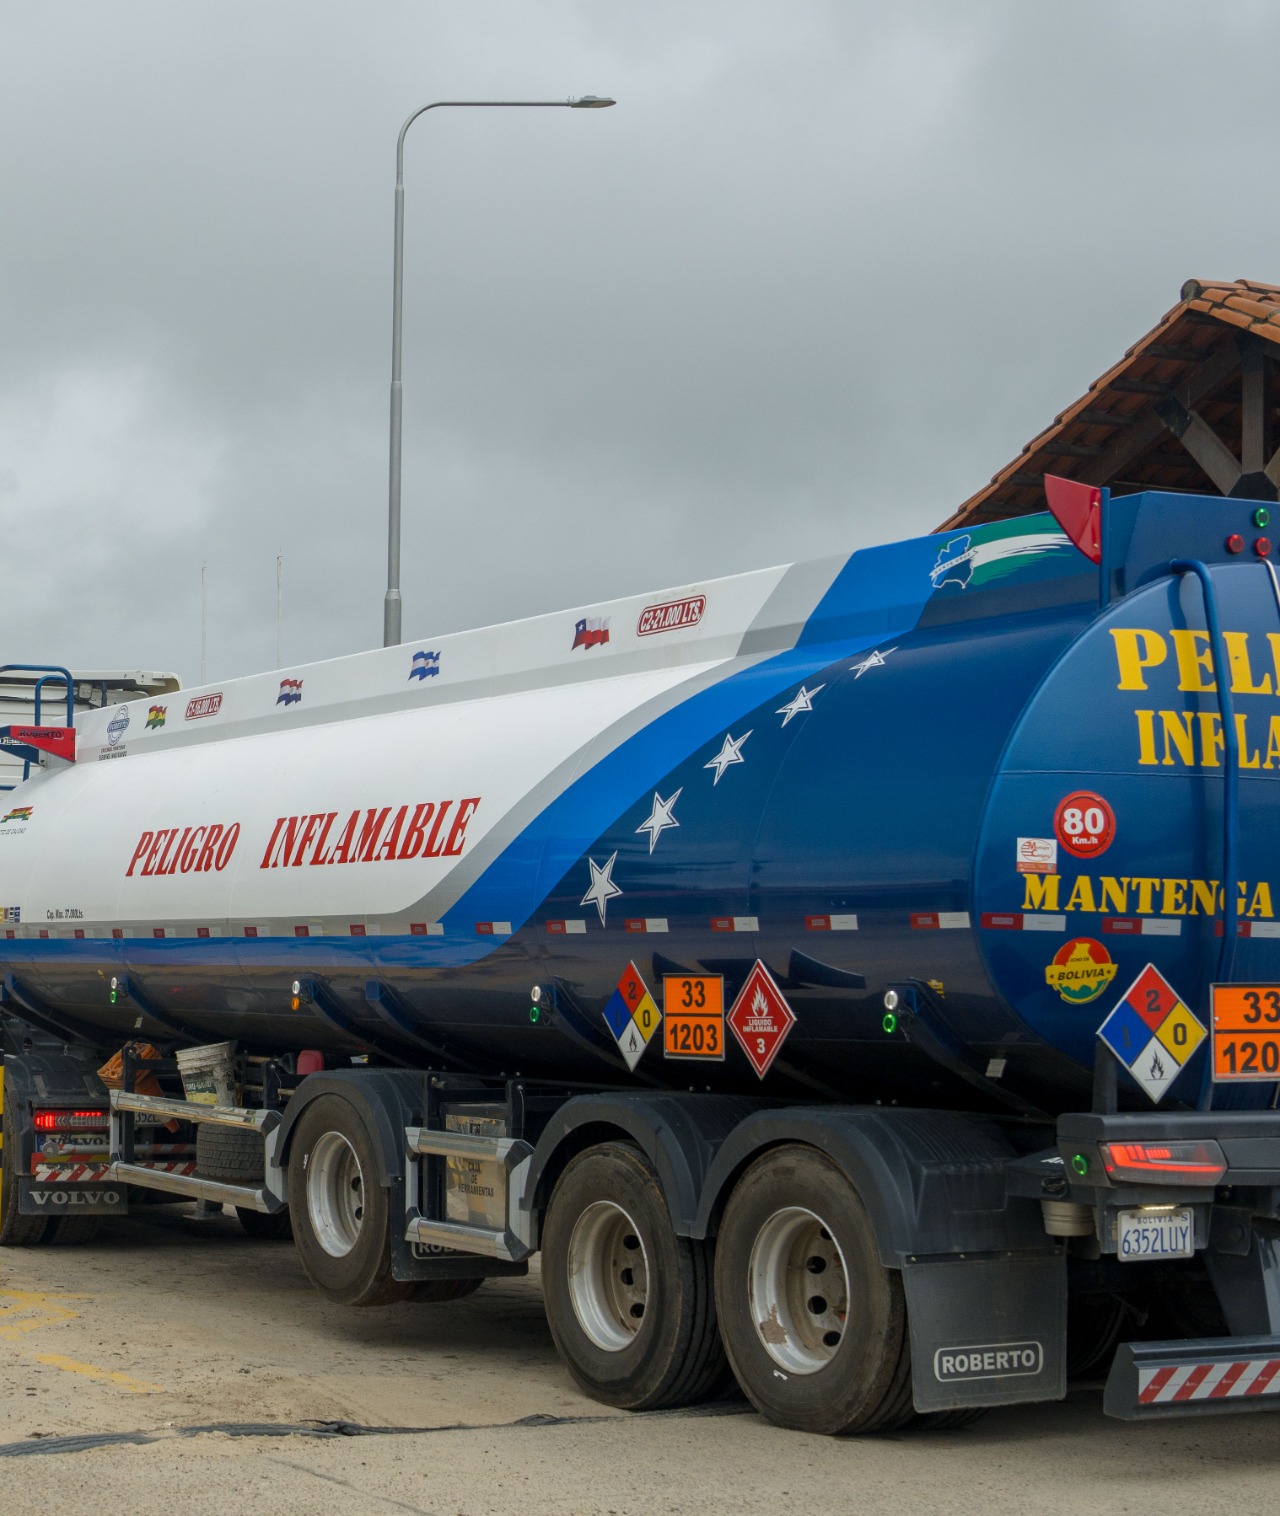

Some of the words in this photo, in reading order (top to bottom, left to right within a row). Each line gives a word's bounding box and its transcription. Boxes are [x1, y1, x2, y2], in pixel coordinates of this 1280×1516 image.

[640, 604, 683, 631] C2-21.000
[682, 601, 701, 622] LTS.
[18, 729, 63, 738] ROBERTO
[1063, 807, 1104, 835] 80
[125, 822, 241, 877] PELIGRO
[260, 797, 481, 869] INFLAMABLE
[1058, 969, 1105, 981] BOLIVIA
[628, 981, 637, 999] 2
[682, 980, 705, 1007] 33
[1145, 989, 1161, 1012] 2
[1243, 991, 1280, 1023] 33
[642, 1009, 651, 1028] 0
[748, 1018, 772, 1026] LIQUIDO
[670, 1023, 718, 1052] 1203
[757, 1038, 766, 1054] 3
[1122, 1025, 1131, 1049] 1
[1173, 1022, 1187, 1046] 0
[1222, 1041, 1280, 1074] 120
[467, 1161, 481, 1173] CAJA
[471, 1174, 478, 1184] DE
[29, 1190, 120, 1205] VOLVO
[458, 1183, 494, 1198] HERRAMIENTAS
[1136, 1215, 1174, 1225] BOLIVIA
[1122, 1225, 1189, 1255] 6352LUY
[941, 1349, 1036, 1375] ROBERTO
